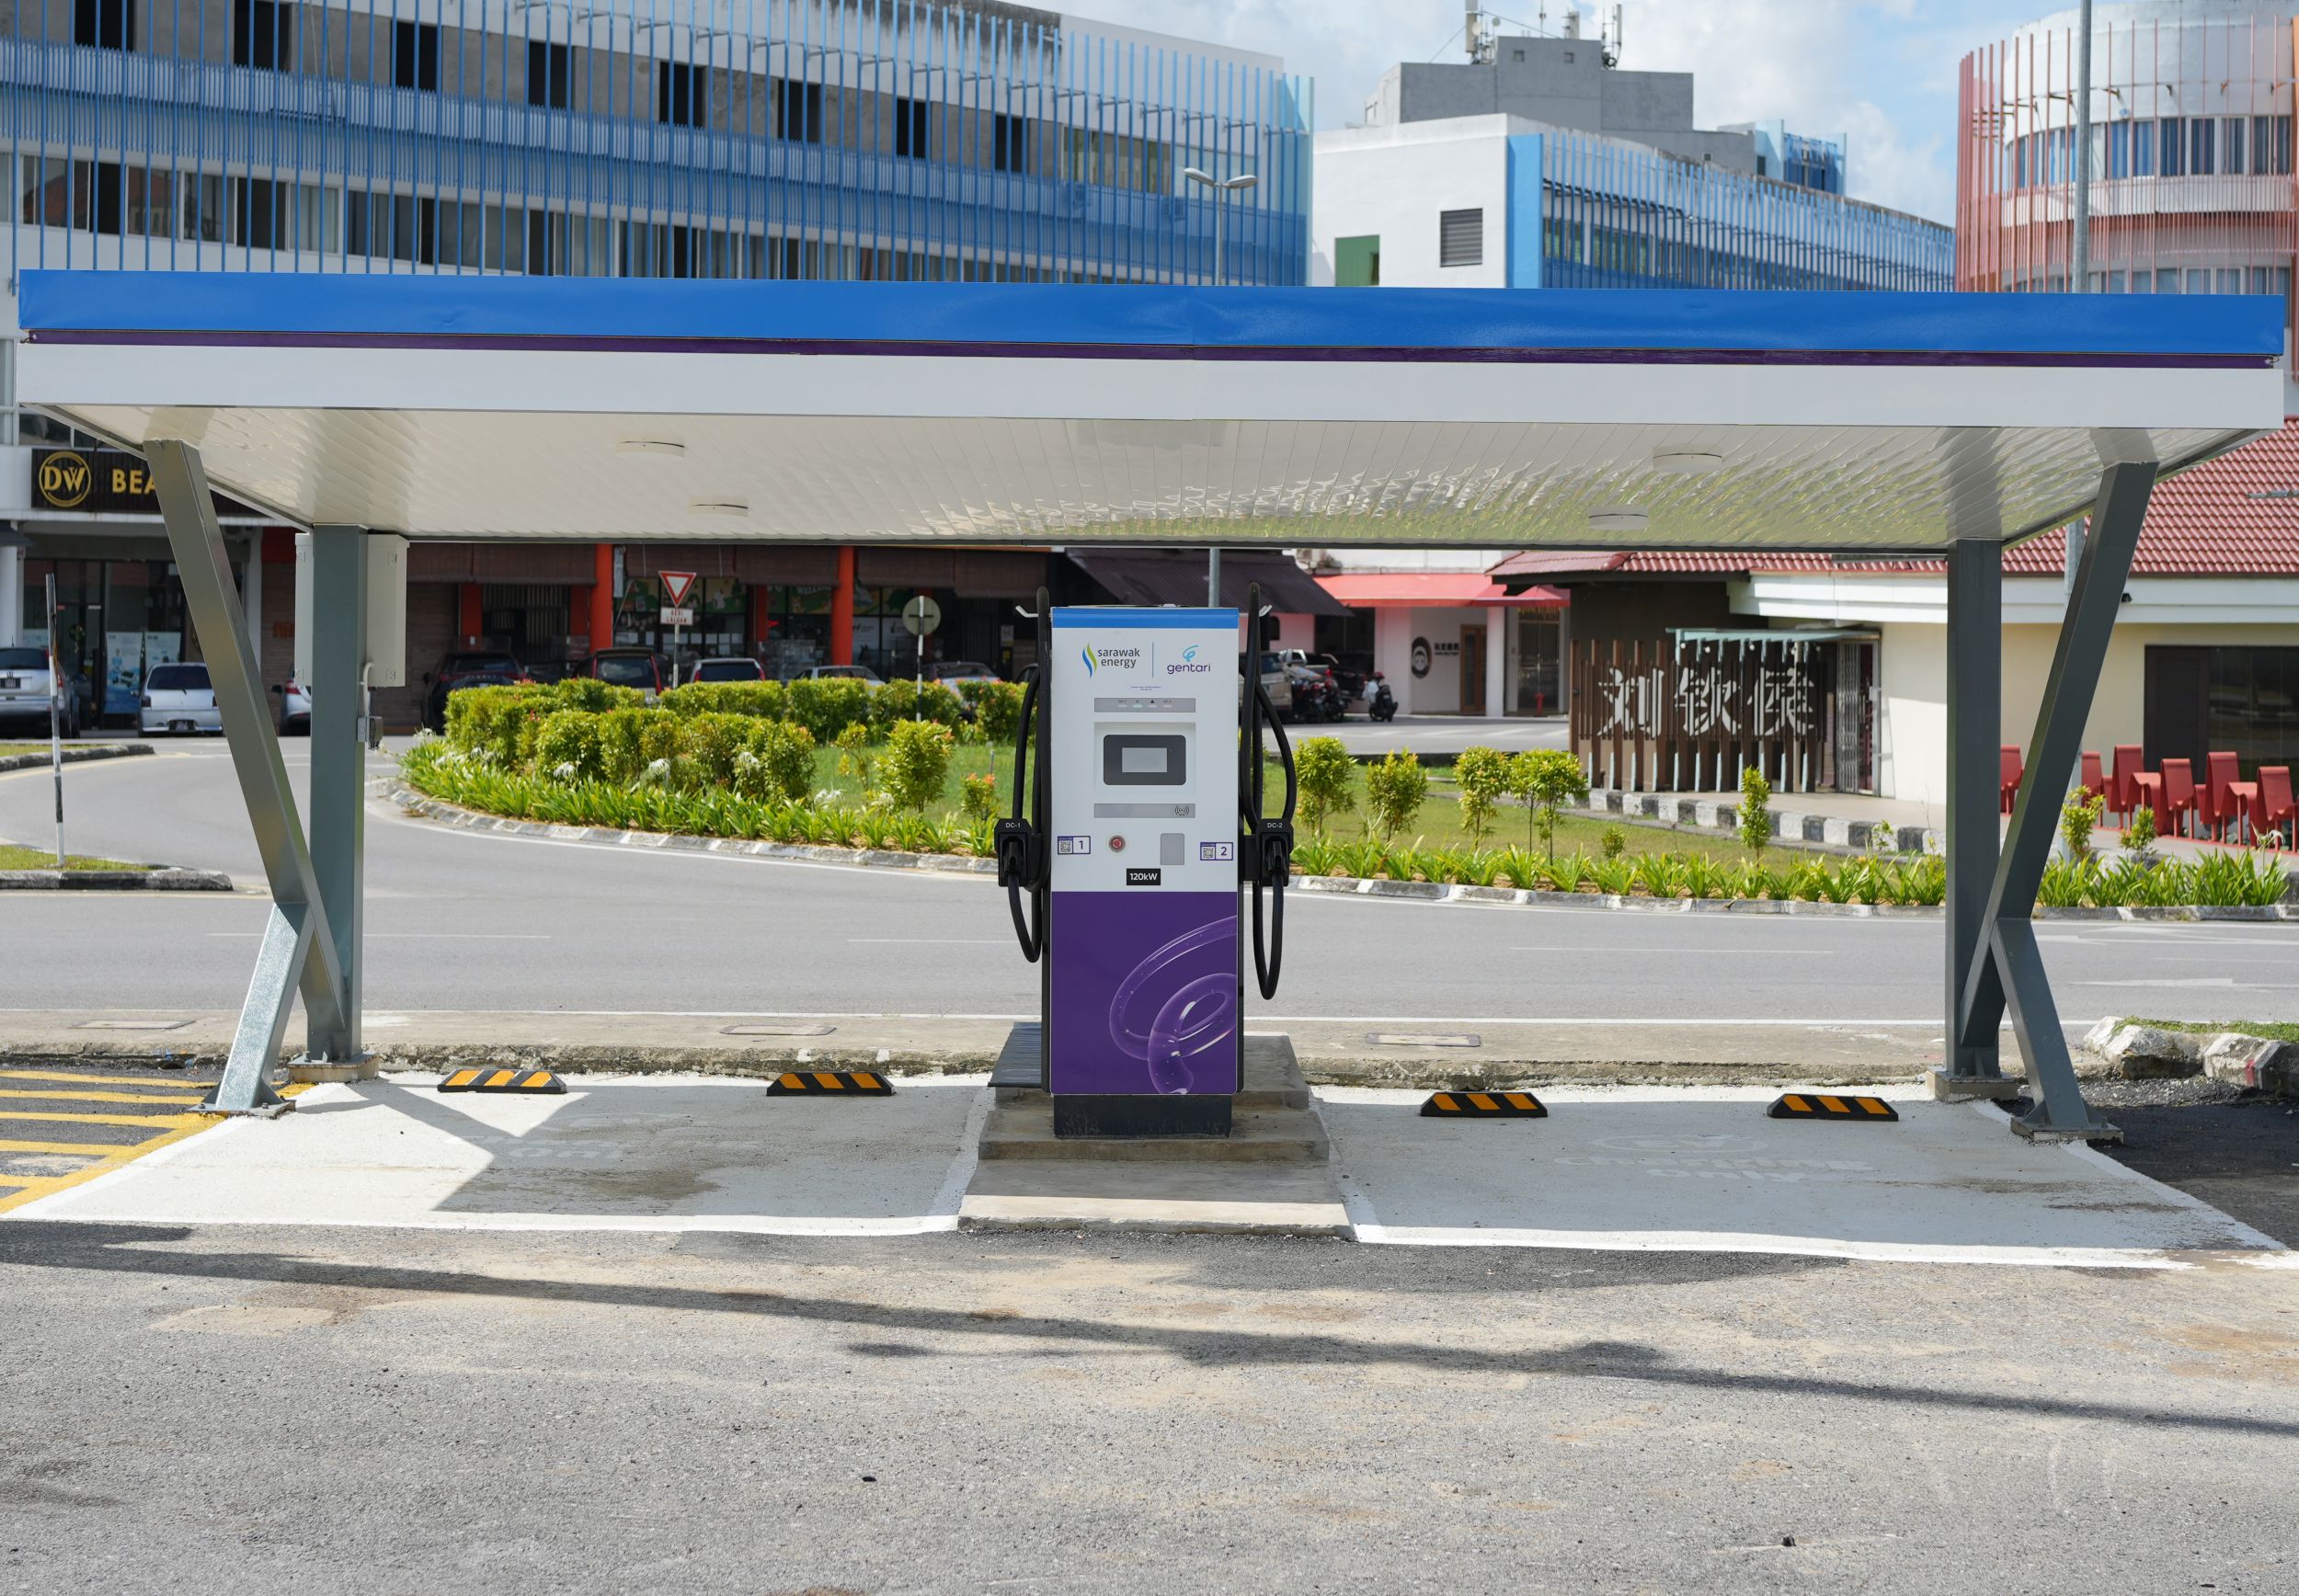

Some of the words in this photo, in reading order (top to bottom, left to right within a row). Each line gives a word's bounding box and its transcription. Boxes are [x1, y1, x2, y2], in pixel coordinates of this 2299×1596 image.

[43, 465, 86, 493] DW
[1097, 647, 1140, 657] sarawak
[1101, 657, 1137, 669] energy
[1166, 663, 1211, 675] gentari
[1079, 840, 1083, 850] 1
[1220, 846, 1228, 856] 2
[1129, 872, 1158, 881] 120kW
[1646, 1168, 1806, 1183] only
